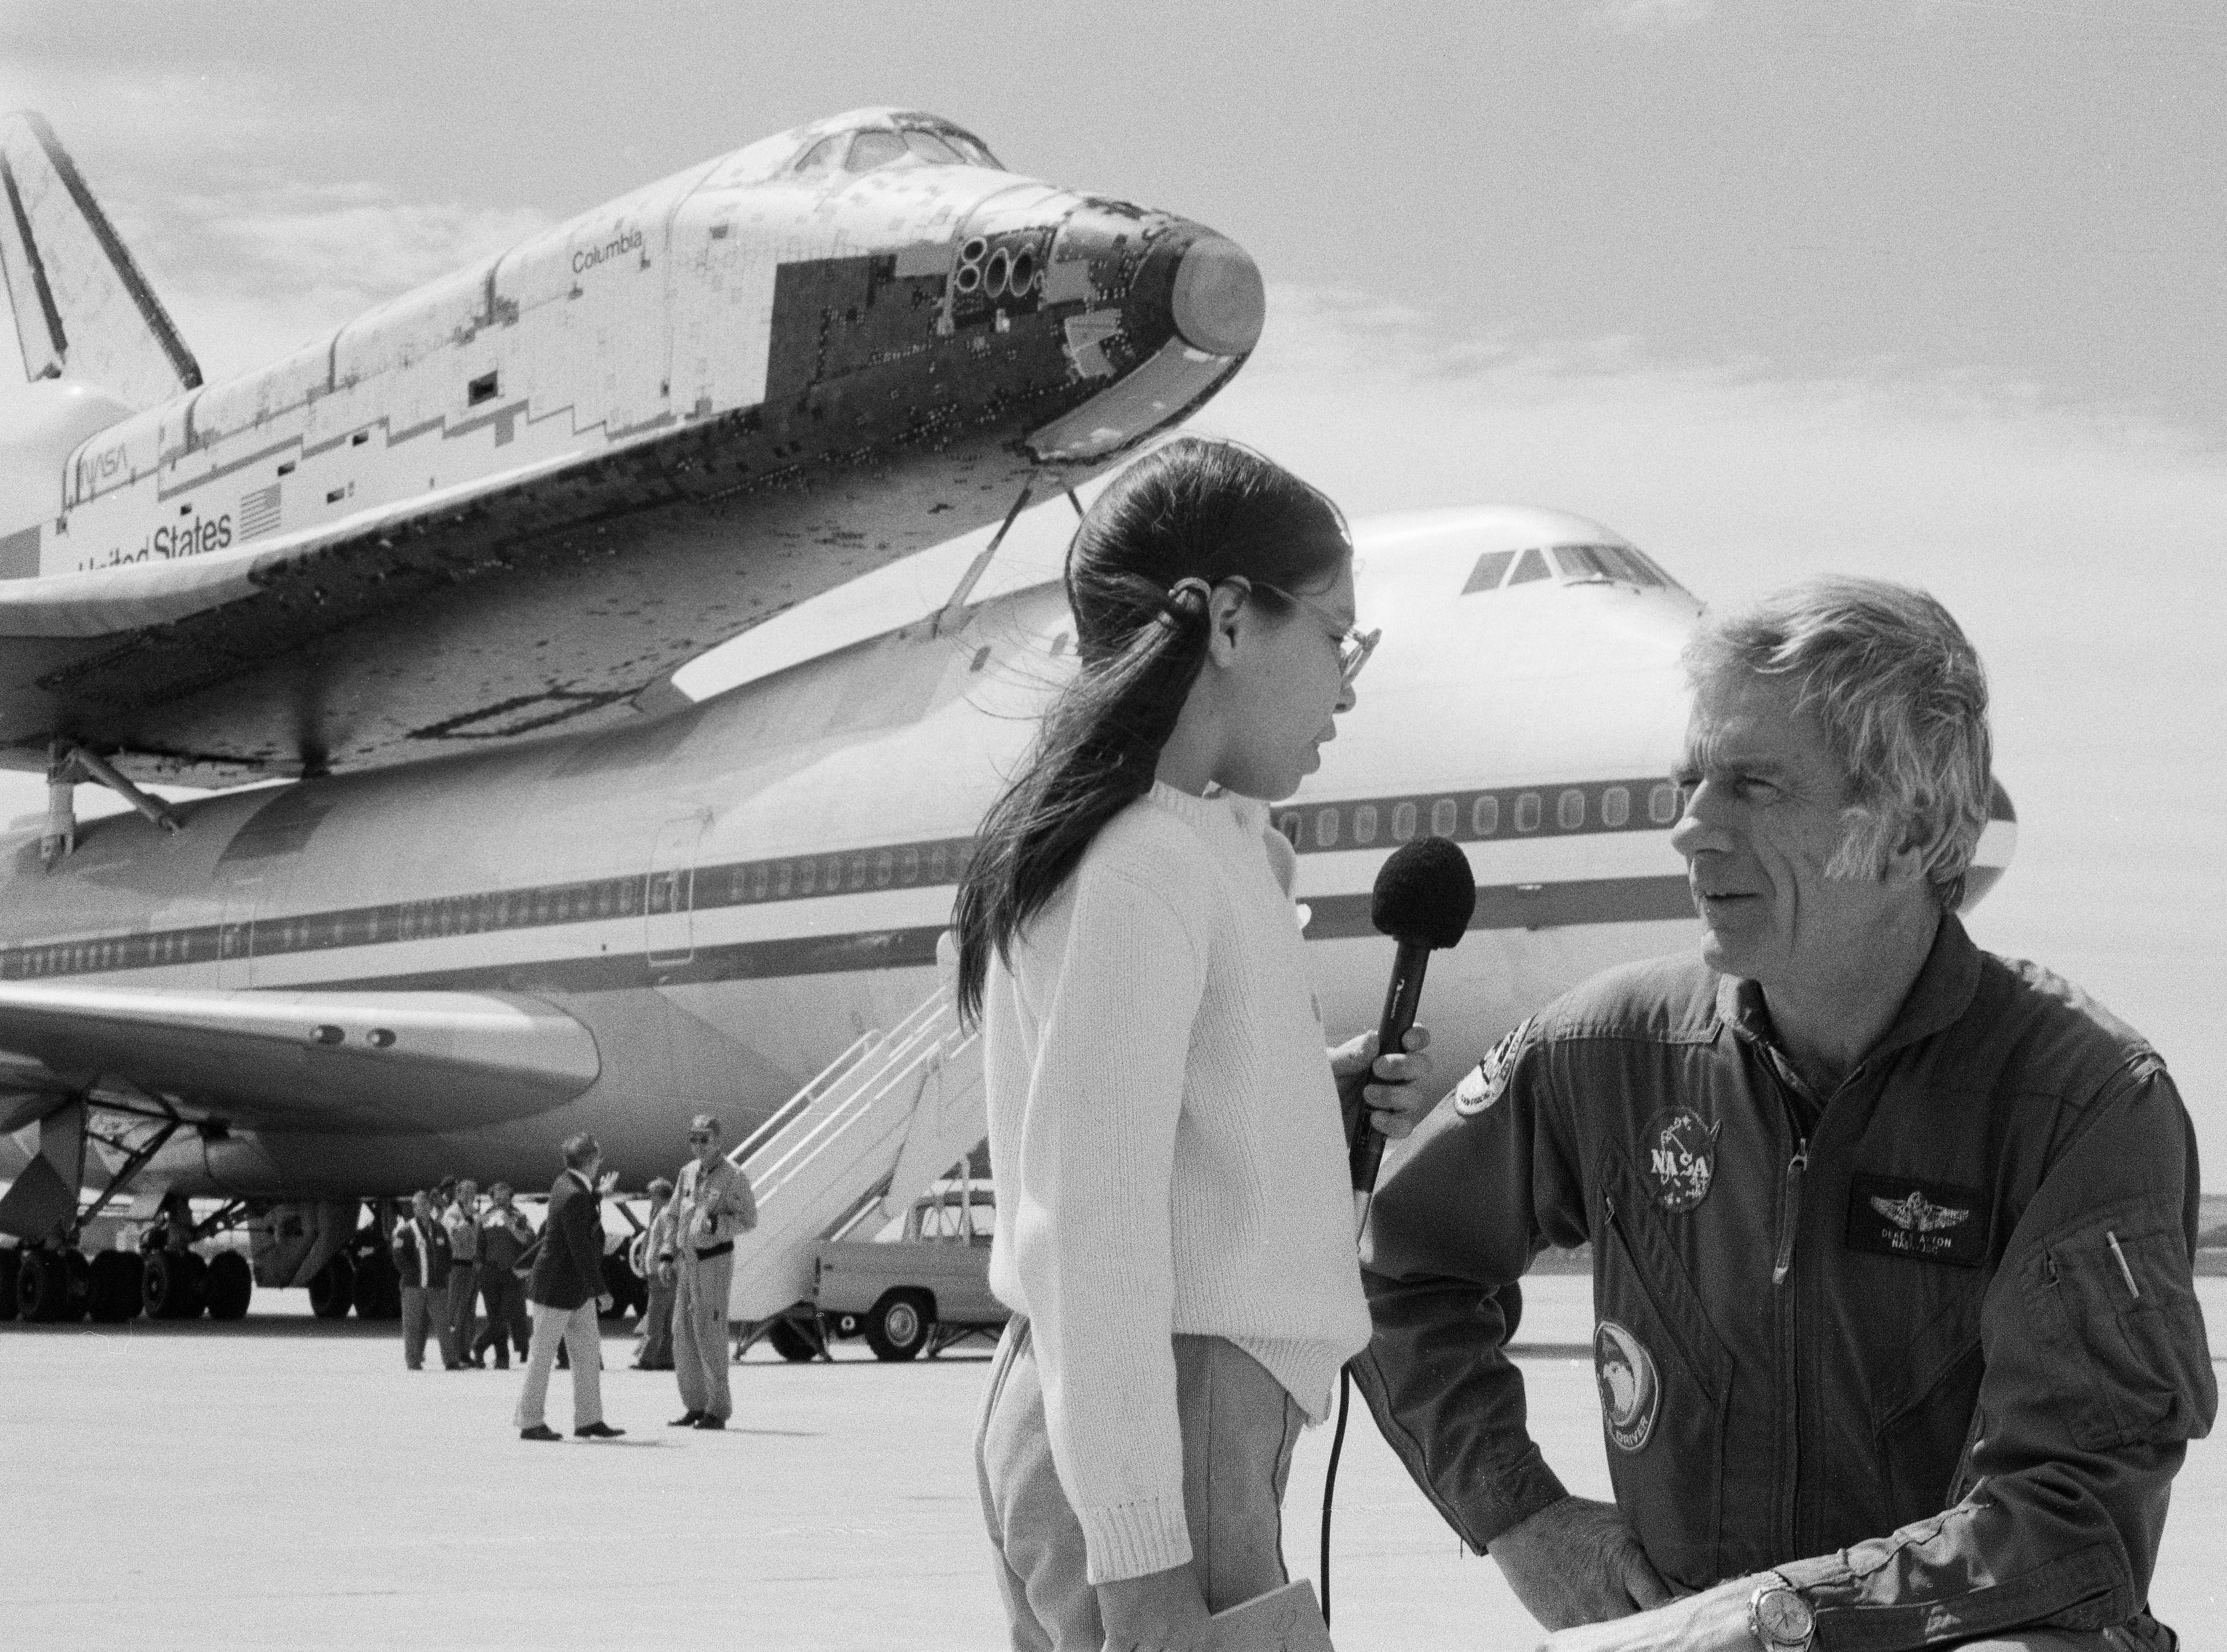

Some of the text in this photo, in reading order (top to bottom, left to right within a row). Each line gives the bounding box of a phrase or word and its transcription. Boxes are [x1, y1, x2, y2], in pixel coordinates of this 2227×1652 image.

[571, 228, 643, 274] Columbia
[82, 442, 128, 489] NASA
[153, 514, 232, 559] States
[1651, 1148, 1709, 1178] NASA
[1616, 1415, 1649, 1446] DRIVER
